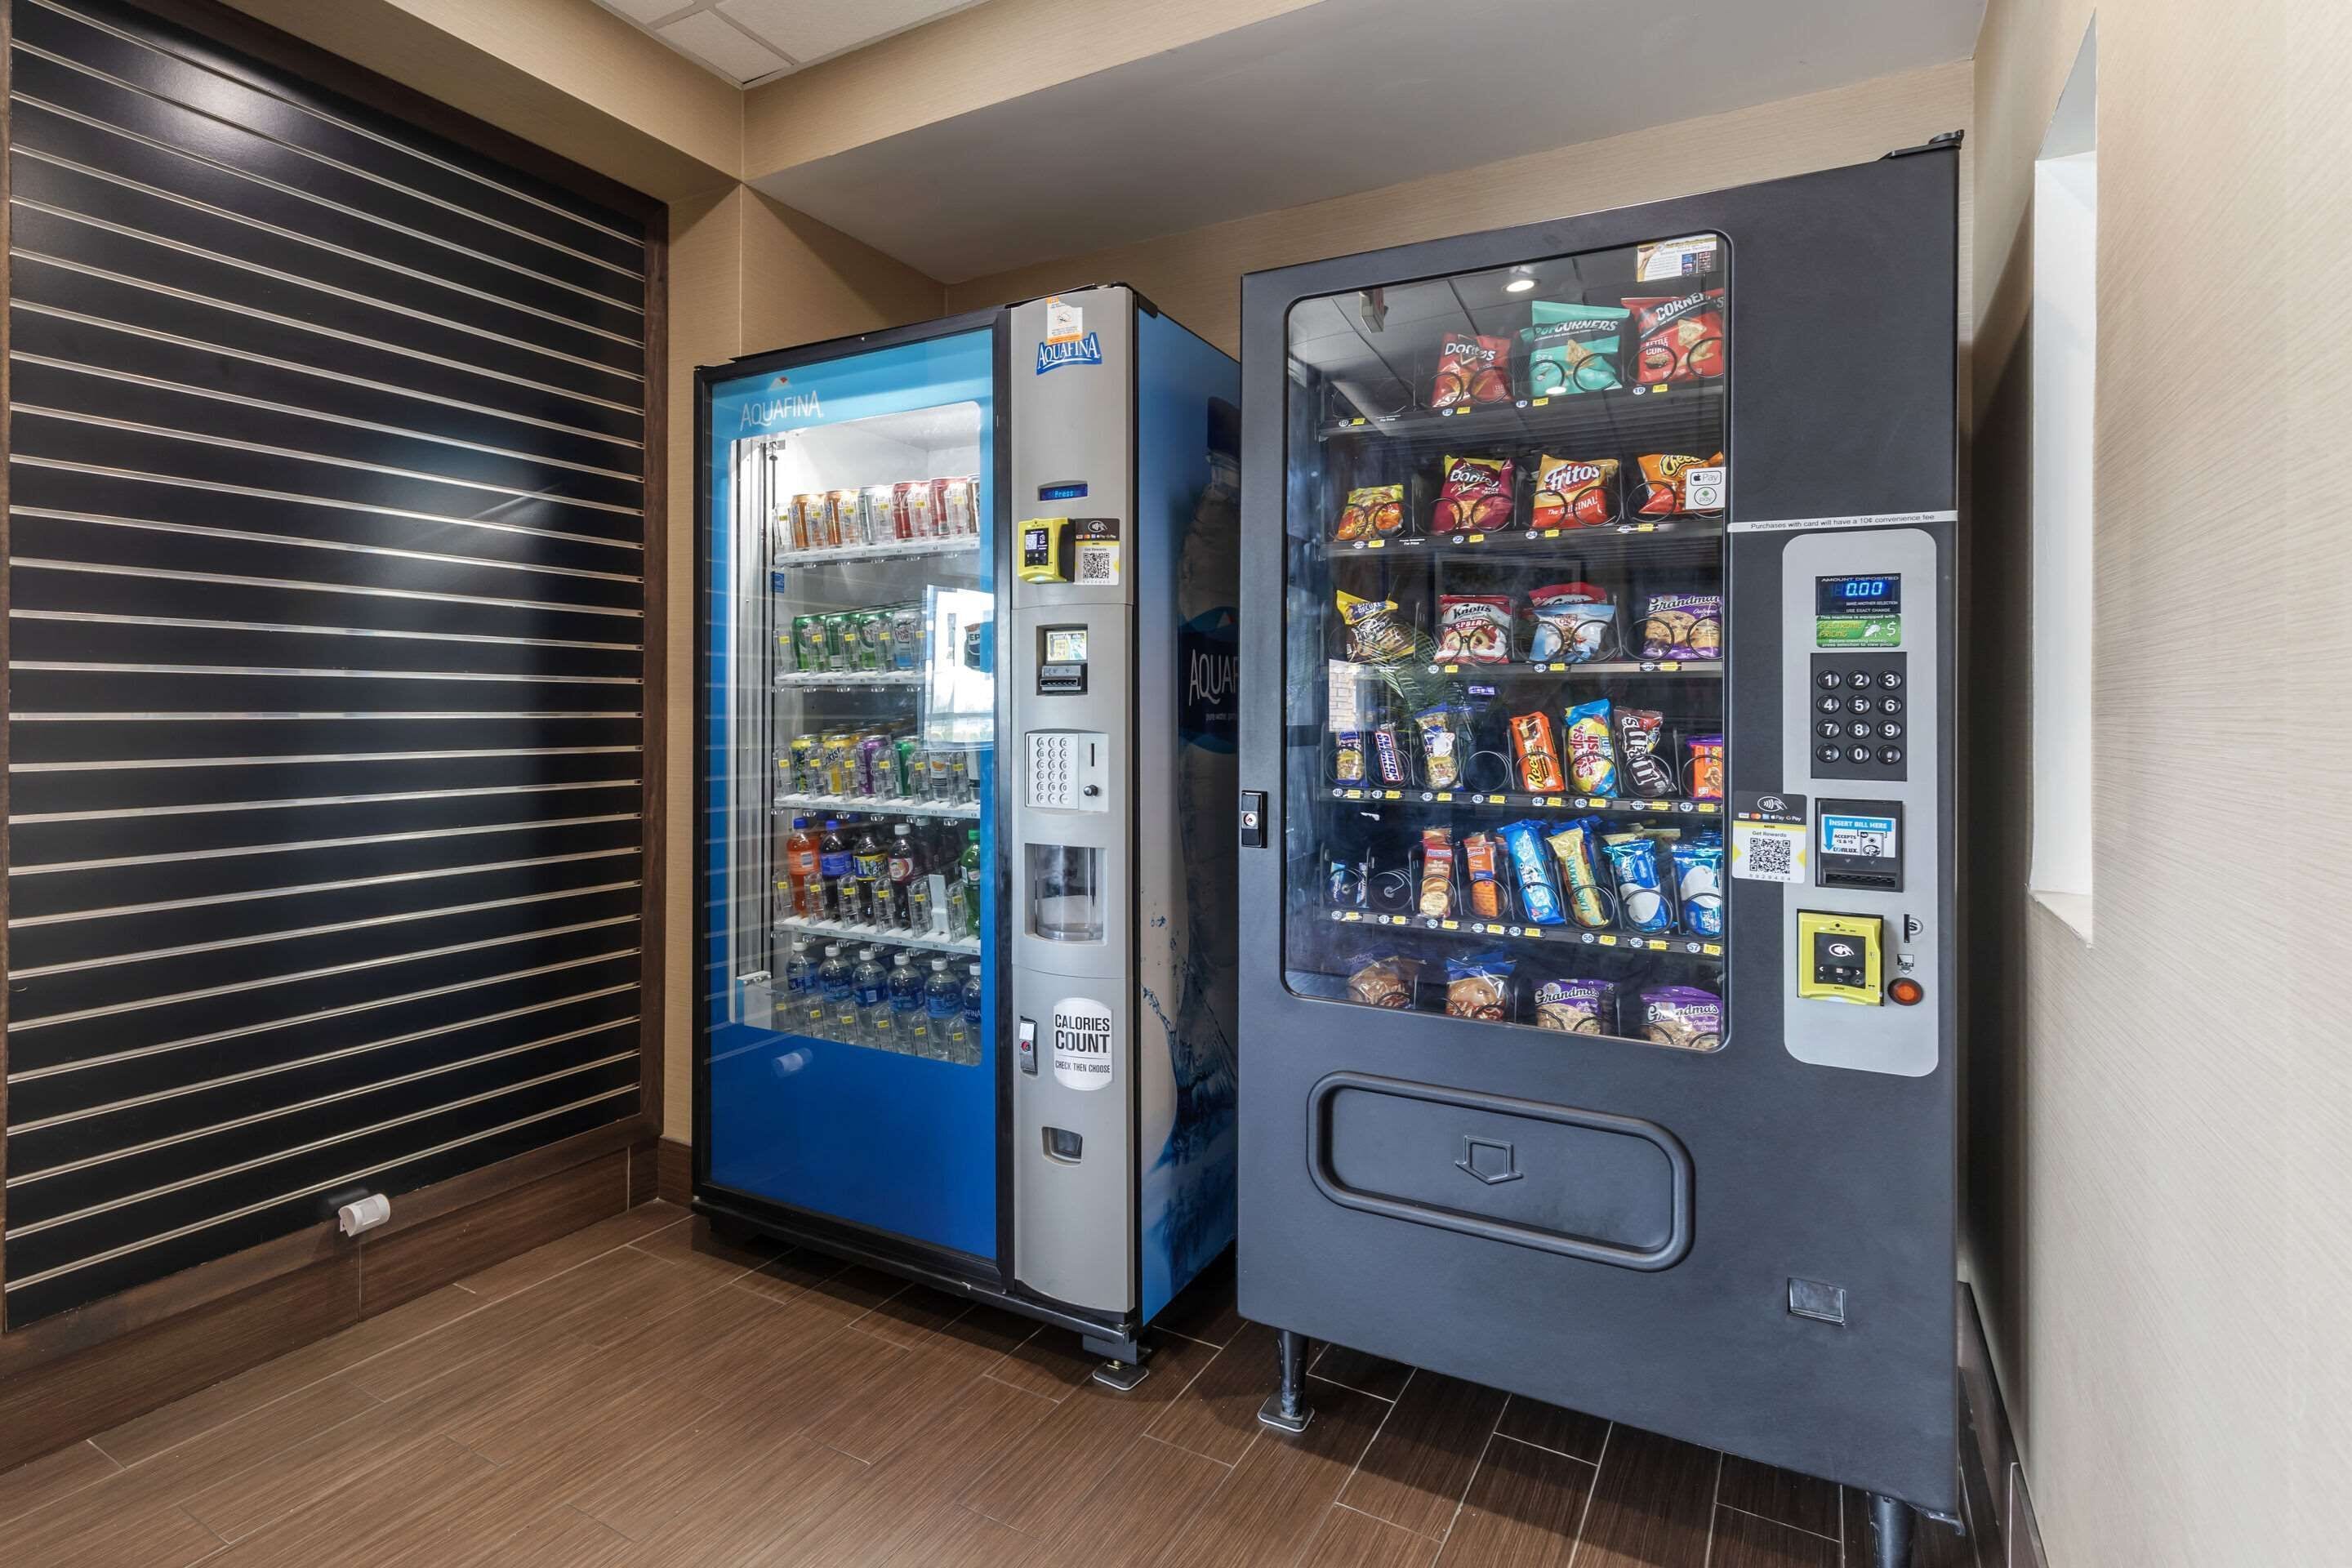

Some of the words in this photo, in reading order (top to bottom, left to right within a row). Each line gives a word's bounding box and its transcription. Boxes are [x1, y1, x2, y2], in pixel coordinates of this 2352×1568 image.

[1037, 334, 1101, 369] AQUAFINA
[740, 390, 823, 432] AQUAFINA
[1450, 469, 1500, 488] Dorito
[1544, 464, 1601, 493] Fritos
[1702, 473, 1719, 483] Pay
[1874, 514, 1921, 523] convenience
[1846, 581, 1882, 596] 0.00
[1647, 595, 1720, 614] Grandma
[1886, 621, 1896, 636] $
[1189, 649, 1239, 706] AQUAF
[1824, 674, 1832, 686] 1
[1855, 675, 1864, 686] 2
[1885, 675, 1895, 686] 3
[1824, 699, 1833, 710] 4
[1855, 700, 1864, 711] 5
[1885, 700, 1895, 712] 6
[1824, 724, 1833, 736] 7
[1855, 724, 1864, 736] 8
[1885, 724, 1895, 737] 9
[1378, 734, 1398, 781] SNCKERS
[1572, 724, 1585, 778] Swdish
[1854, 748, 1863, 760] 0
[1535, 987, 1600, 1005] Grandma's
[1647, 1004, 1719, 1022] Grndma's
[1055, 1013, 1110, 1032] CALORIES
[1055, 1060, 1071, 1071] CHECK
[1073, 1062, 1087, 1072] THEN
[1089, 1064, 1111, 1074] CHOOSE
